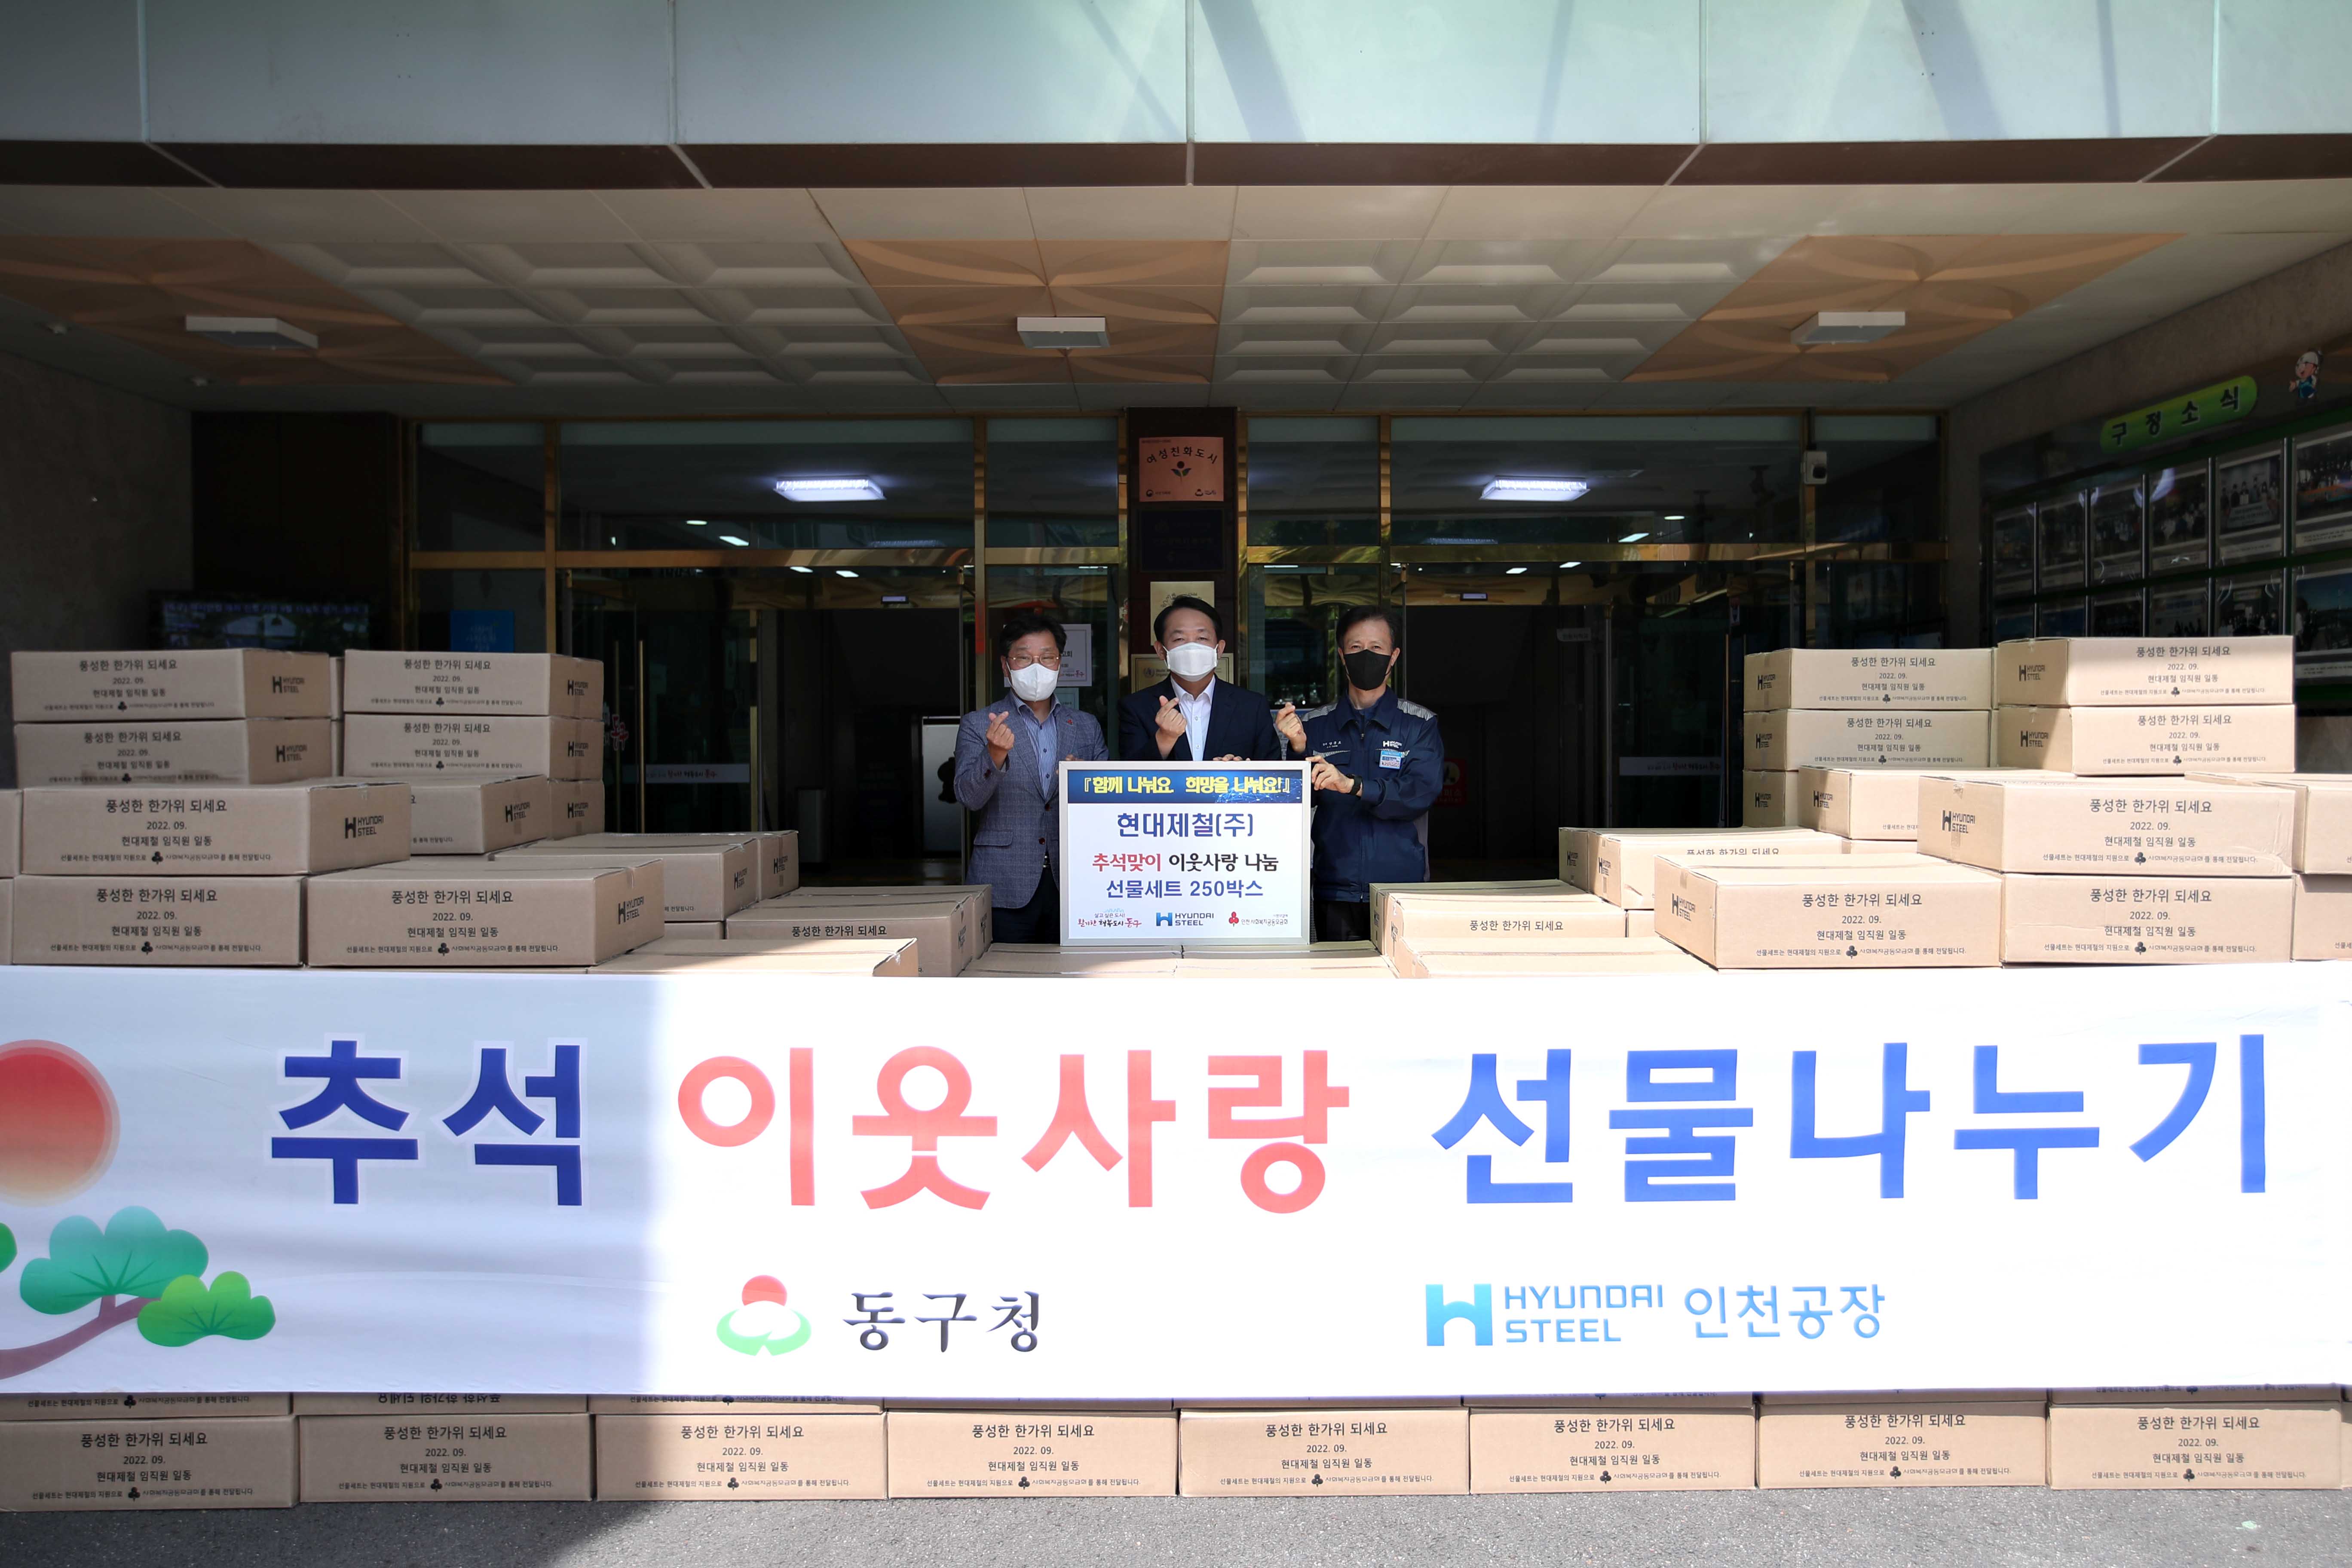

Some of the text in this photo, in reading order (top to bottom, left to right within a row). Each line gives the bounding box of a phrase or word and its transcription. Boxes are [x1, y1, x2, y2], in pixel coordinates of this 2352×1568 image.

[2112, 386, 2239, 446] 구정소식
[1146, 446, 1217, 464] 여성친화도시
[2136, 646, 2231, 658] 풍성한 한가위 되세요
[79, 659, 177, 672] 풍성한 한가위 되세요
[404, 659, 491, 670] 풍성한 한가위 되세요
[1851, 657, 1936, 667] 풍성한 한가위 되세요
[1185, 777, 1229, 793] 희망을
[106, 799, 227, 813] 풍성한 한가위 되세요
[513, 802, 530, 812] HYUNDAI
[2089, 799, 2212, 814] 풍성한 한가위 되세요
[357, 815, 384, 825] HYUNDAI
[513, 812, 527, 821] STEEL
[1952, 812, 1975, 824] HYUNDAI
[147, 821, 187, 830] 2022. 09.
[357, 826, 377, 836] STEEL
[1117, 812, 1254, 838] 현대제철(주)
[1952, 823, 1969, 834] STEEL
[122, 836, 212, 847] 현대제철 임직원 일동
[1092, 853, 1279, 873] 추석맞이 이웃사랑 나눔
[96, 888, 217, 903] 풍성한 한가위 되세요
[1106, 879, 1263, 899] 선물세트 250박스
[2090, 888, 2212, 903] 풍성한 한가위 되세요
[392, 890, 514, 904] 풍성한 한가위 되세요
[626, 896, 644, 909] HYUNDAI
[1802, 893, 1922, 907] 풍성한 한가위 되세요
[1679, 897, 1696, 912] HYUNDAI
[432, 912, 473, 921] 2022. 09.
[626, 908, 640, 921] STEEL
[1679, 907, 1691, 922] STEEL
[1841, 915, 1881, 924] 2022. 09.
[2129, 911, 2170, 920] 2022. 09.
[1078, 918, 1142, 928] 활기찬 행복도시 동구
[1470, 920, 1564, 931] 풍성한 한가위 되세요
[407, 927, 499, 938] 현대제철 임직원 일동
[792, 925, 887, 937] 풍성한 한가위 되세요
[1816, 930, 1906, 941] 현대제철 임직원 일동
[2104, 925, 2196, 937] 현대제철 임직원 일동
[271, 1034, 2266, 1213] 추석 이웃사랑 선물나누기
[1505, 1285, 1663, 1308] HYUNDAI
[1683, 1283, 1886, 1339] 인천공장
[844, 1290, 1041, 1353] 동구청
[1505, 1319, 1621, 1343] STEEL
[1554, 1418, 1675, 1433] 풍성한 한가위 되세요
[1844, 1414, 1966, 1429] 풍성한 한가위 되세요
[2137, 1416, 2260, 1430] 풍성한 한가위 되세요
[384, 1426, 507, 1440] 풍성한 한가위 되세요
[681, 1425, 804, 1439] 풍성한 한가위 되세요
[972, 1424, 1095, 1438] 풍성한 한가위 되세요
[1265, 1421, 1387, 1437] 풍성한 한가위 되세요
[81, 1431, 208, 1448] 풍성한 한가위 되세요
[2178, 1438, 2218, 1447] 2022. 09.
[425, 1448, 466, 1457] 2022. 09.
[1306, 1444, 1347, 1453] 2022. 09.
[1281, 1458, 1372, 1470] 현대제철 임직원 일동
[2153, 1453, 2245, 1464] 현대제철 임직원 일동
[400, 1463, 492, 1474] 현대제철 임직원 일동
